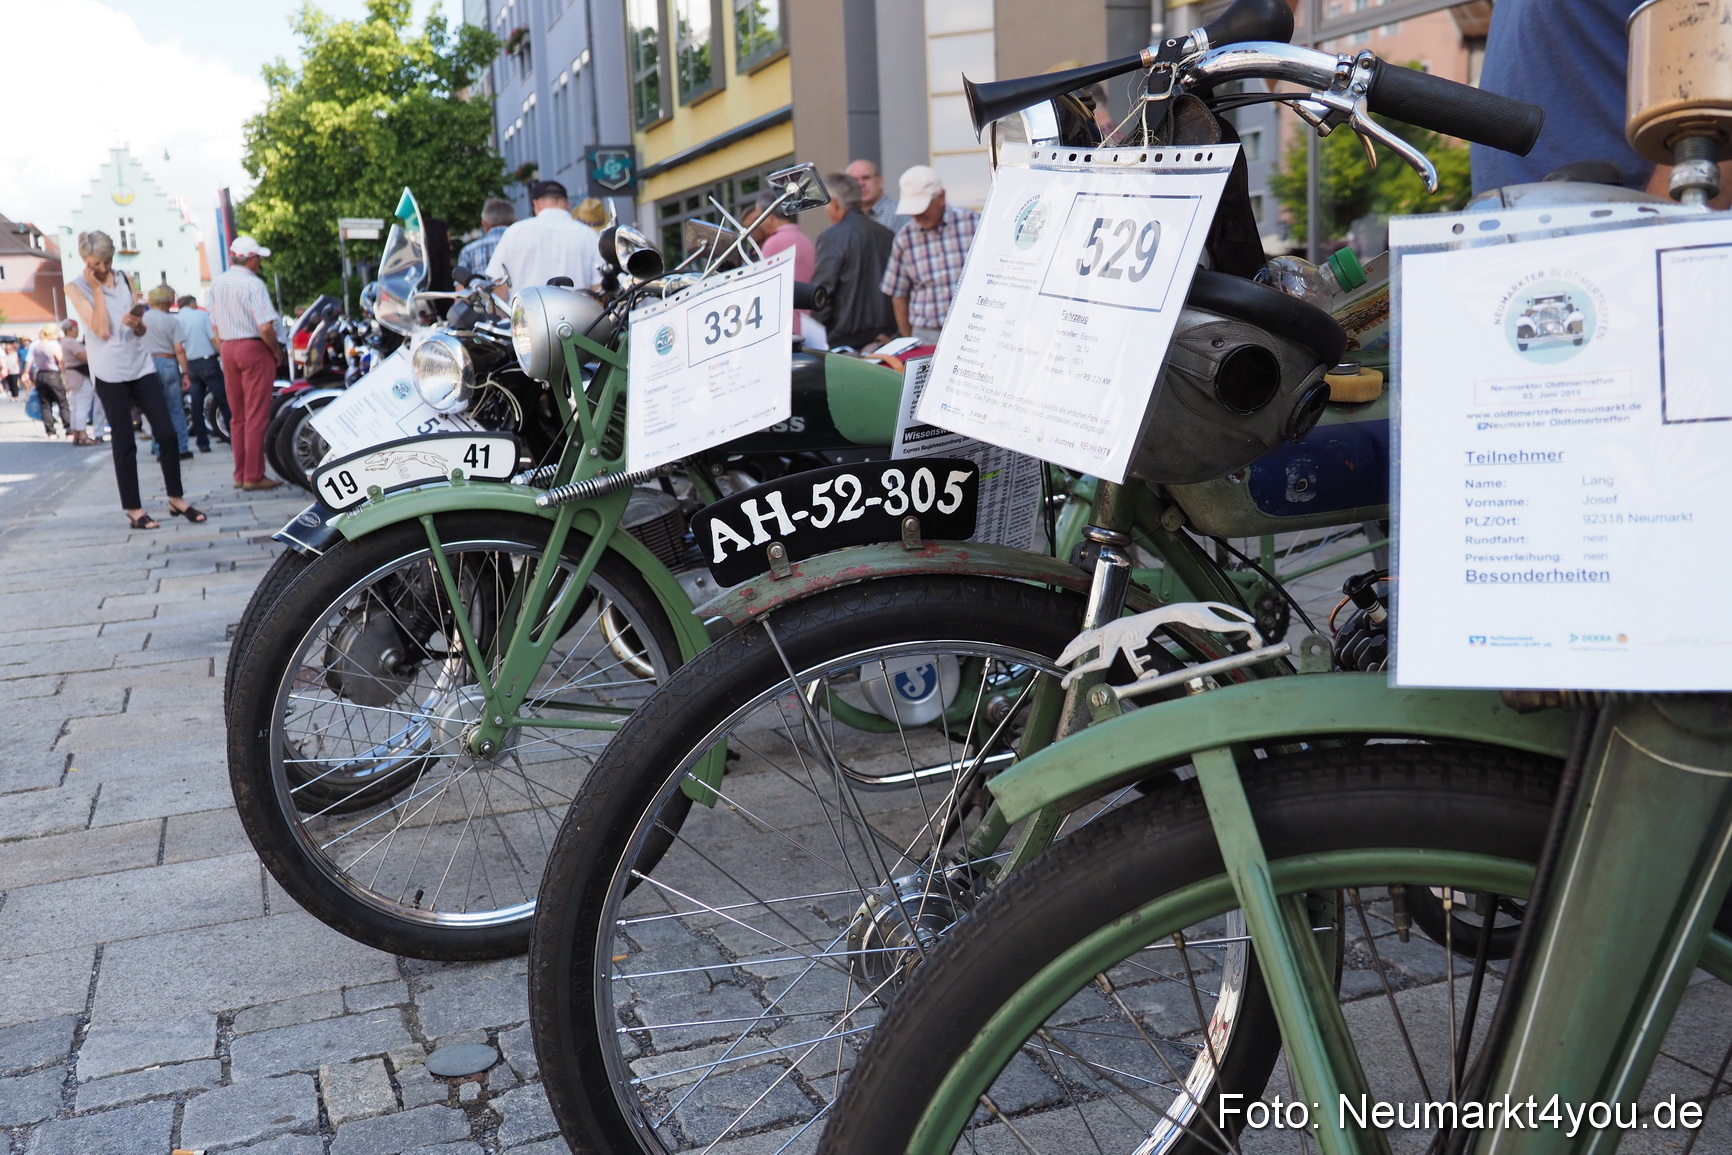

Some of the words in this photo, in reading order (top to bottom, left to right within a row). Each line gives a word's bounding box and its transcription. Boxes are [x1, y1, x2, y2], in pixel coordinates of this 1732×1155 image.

[1075, 216, 1162, 283] 529
[976, 296, 1006, 308] Teilnehmer
[1494, 270, 1545, 325] NEUMARKTER
[1550, 268, 1609, 341] OLDTIMERTREFFEN
[704, 296, 763, 345] 334
[1061, 311, 1089, 323] Fahrzeug
[1491, 382, 1542, 392] Neumarkter
[1545, 377, 1614, 389] Oldtimertreffen
[1539, 391, 1557, 399] Juni
[1466, 403, 1642, 419] www.oldtimertreffen-neumarkt.de
[1486, 419, 1545, 430] Neumarkter
[1550, 415, 1630, 427] Oldtimertreffen
[1054, 436, 1074, 447] auctores
[1079, 441, 1106, 456] NEUMARKT
[463, 443, 491, 469] 41
[1465, 450, 1564, 465] Teilnehmer
[324, 470, 359, 501] 19
[1465, 479, 1507, 489] Name:
[1582, 476, 1614, 487] Lang
[1465, 498, 1529, 508] Vorname:
[1582, 494, 1618, 506] Josef
[710, 467, 973, 563] AH-52-305
[1465, 516, 1520, 527] PLZ/Ort:
[1583, 513, 1624, 525] 92318
[1628, 512, 1693, 524] Neumarkt
[1465, 535, 1528, 545] Rundfahrt:
[1583, 533, 1607, 542] nein
[1465, 553, 1563, 563] Preisverleihung:
[1583, 552, 1608, 561] nein
[1465, 569, 1611, 583] Besonderheiten
[1582, 634, 1612, 642] DEKRA
